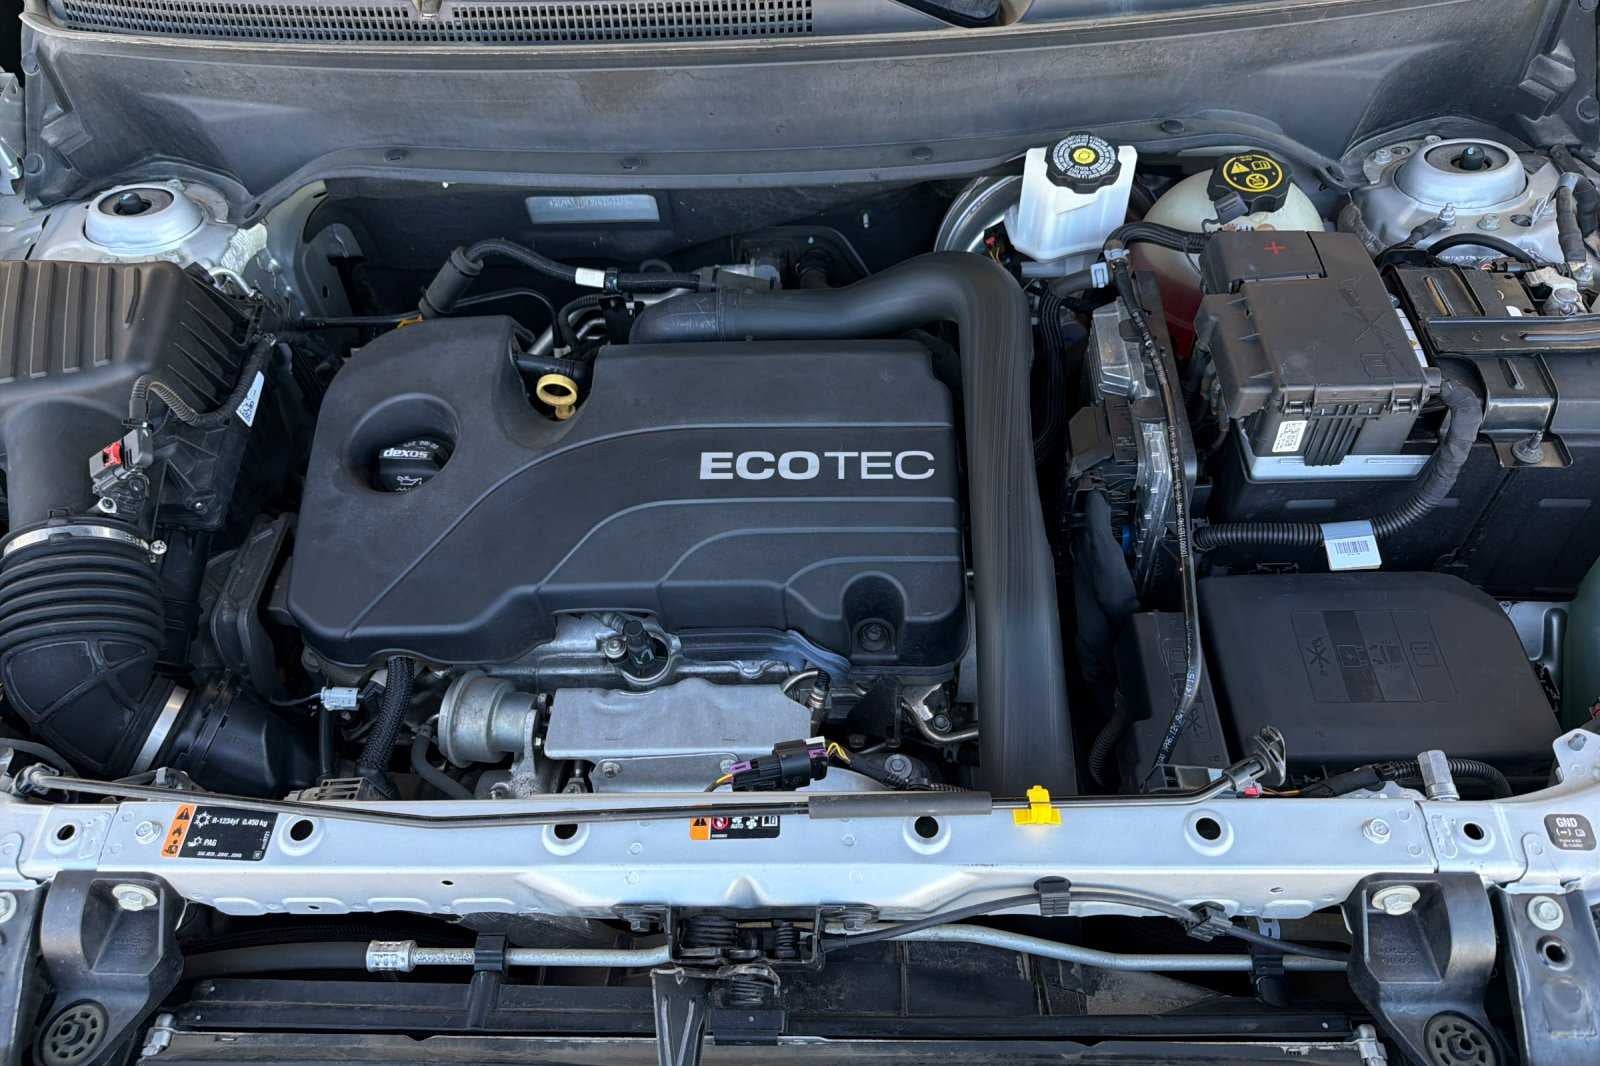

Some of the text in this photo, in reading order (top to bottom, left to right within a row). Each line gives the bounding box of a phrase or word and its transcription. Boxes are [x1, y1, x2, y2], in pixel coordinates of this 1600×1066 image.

[383, 447, 428, 458] dexos
[700, 450, 935, 480] ECOTEC
[1556, 817, 1577, 827] GND
[203, 839, 217, 847] PAG
